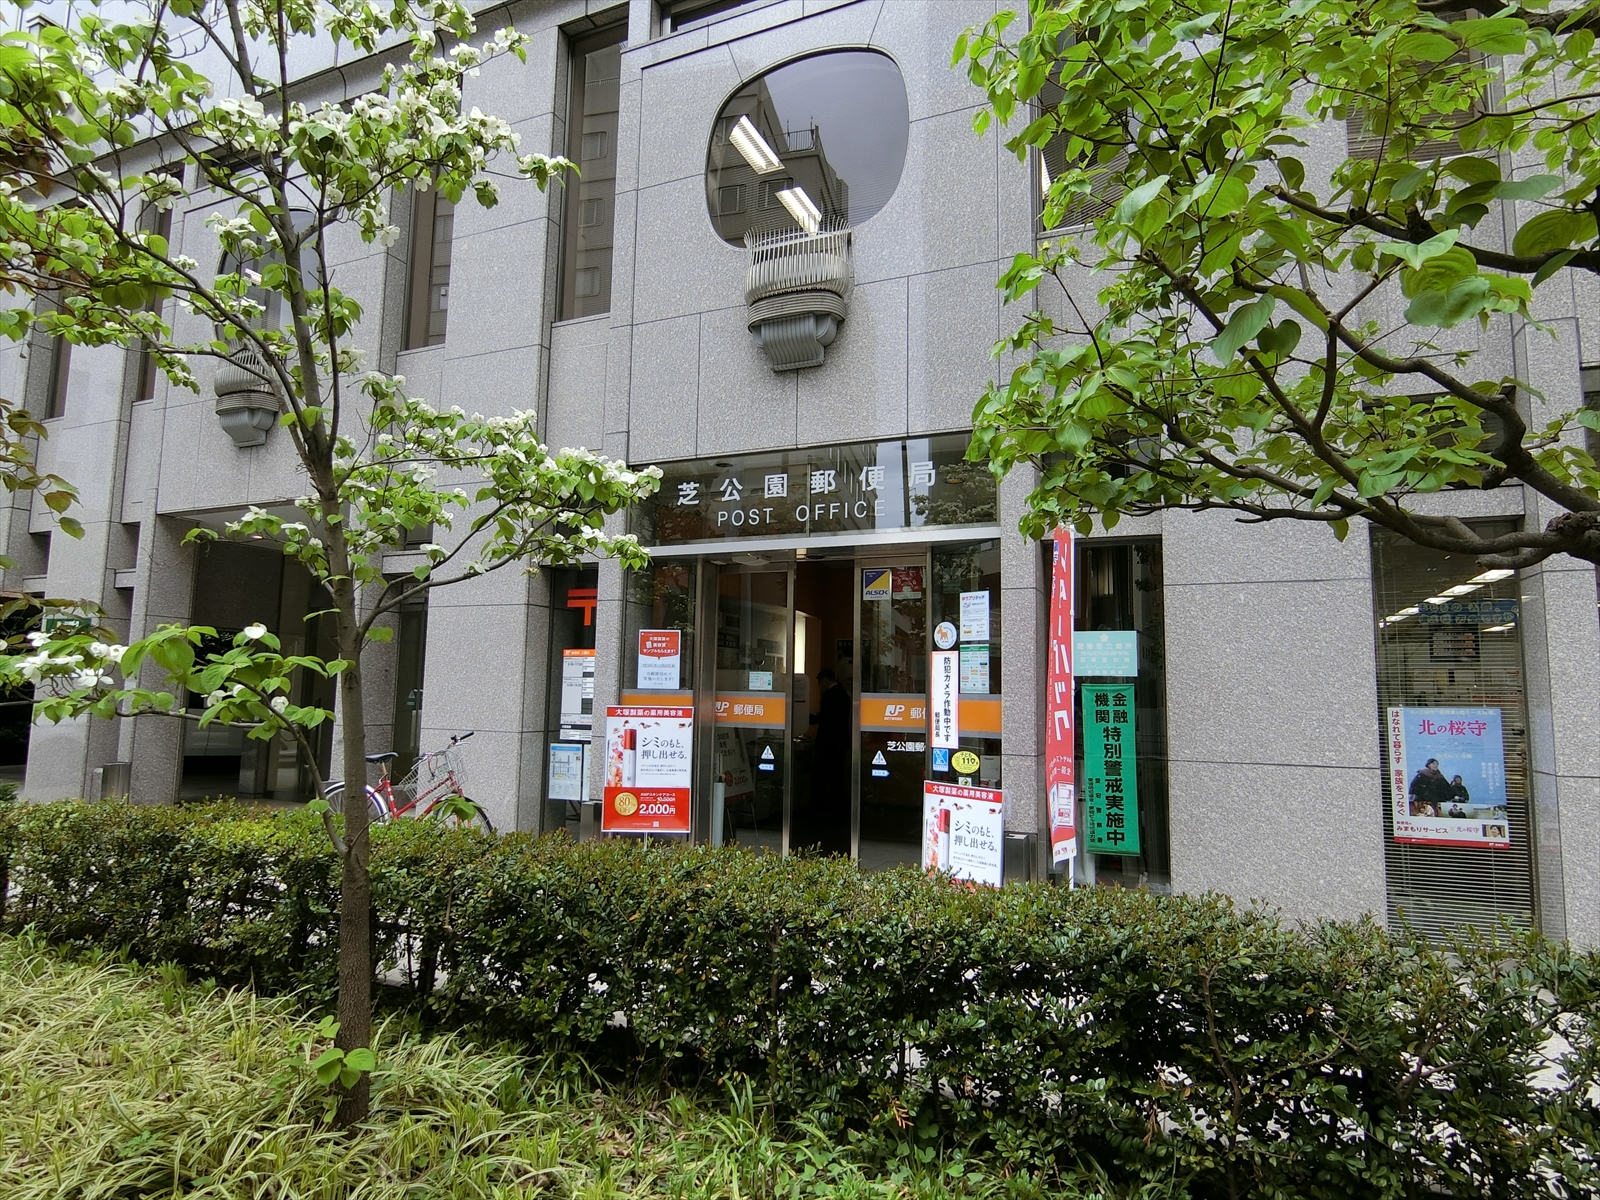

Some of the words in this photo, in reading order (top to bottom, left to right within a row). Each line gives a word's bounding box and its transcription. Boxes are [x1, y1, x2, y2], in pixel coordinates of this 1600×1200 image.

[677, 460, 935, 506] 芝公園郵便局
[717, 507, 774, 527] POST
[796, 499, 886, 522] OFFICE
[943, 656, 951, 742] 防犯カメラ作動中です
[615, 709, 684, 717] 大塚製薬の薬用美容液
[733, 704, 764, 716] 郵便局
[885, 704, 905, 717] JP
[1094, 693, 1110, 724] 機関
[1112, 692, 1129, 724] 金融
[1418, 719, 1487, 737] 北の桜守
[641, 736, 684, 748] シミのもと、
[1391, 710, 1403, 764] はなれて暮らす
[641, 750, 687, 760] 押し出せる。
[886, 741, 926, 752] 芝公園郵
[932, 785, 994, 800] 大塚製薬の薬用美容液
[1103, 726, 1126, 846] 特別警戒実施中
[1394, 769, 1405, 816] 家族をつなぐ
[639, 803, 676, 815] 2,000円
[954, 820, 994, 838] シミのもと、
[1396, 826, 1449, 834] みまもりサービス
[954, 835, 998, 852] 押し出せる。
